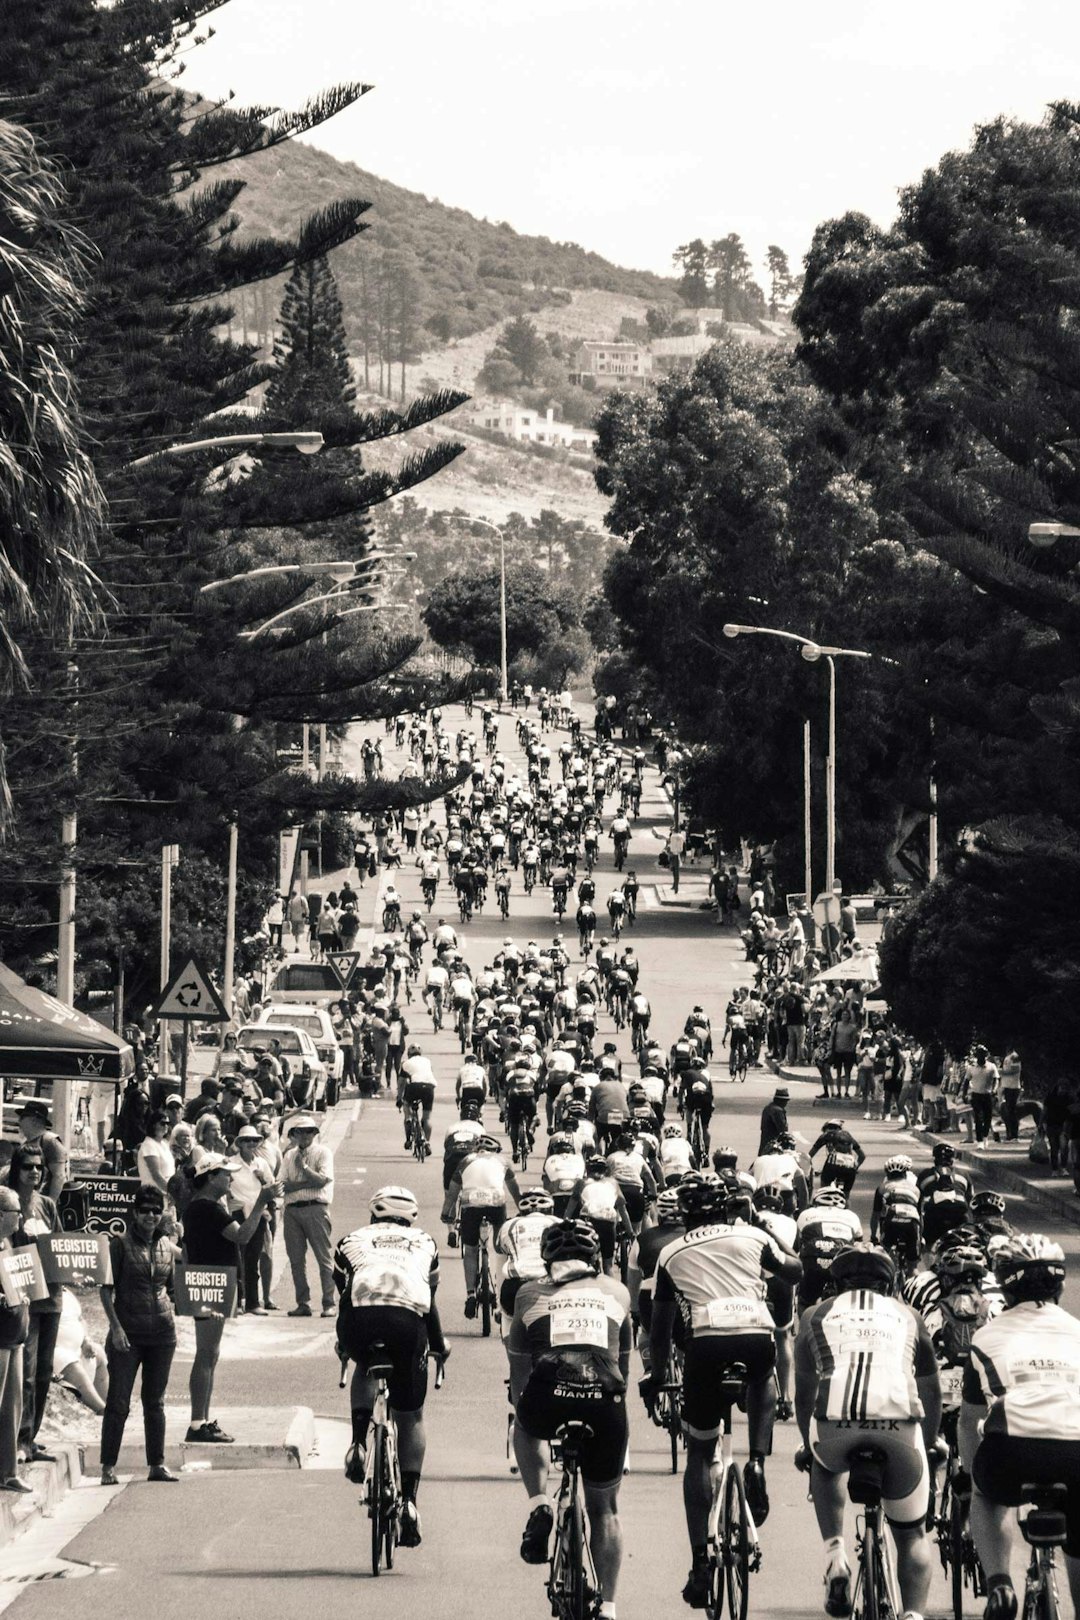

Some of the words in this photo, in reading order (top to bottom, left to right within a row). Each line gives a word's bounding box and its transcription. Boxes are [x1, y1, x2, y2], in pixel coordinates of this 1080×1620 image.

[80, 1181, 118, 1191] CYCLE
[94, 1192, 136, 1203] RENTALS
[51, 1239, 99, 1254] REGISTER
[56, 1255, 70, 1268] TO
[71, 1255, 98, 1269] VOTE
[185, 1271, 227, 1287] REGISTER
[188, 1287, 200, 1302] TO
[201, 1288, 224, 1303] VOTE
[548, 1302, 605, 1311] GIANTS
[568, 1318, 602, 1329] 23310
[554, 1388, 603, 1399] GIANTS
